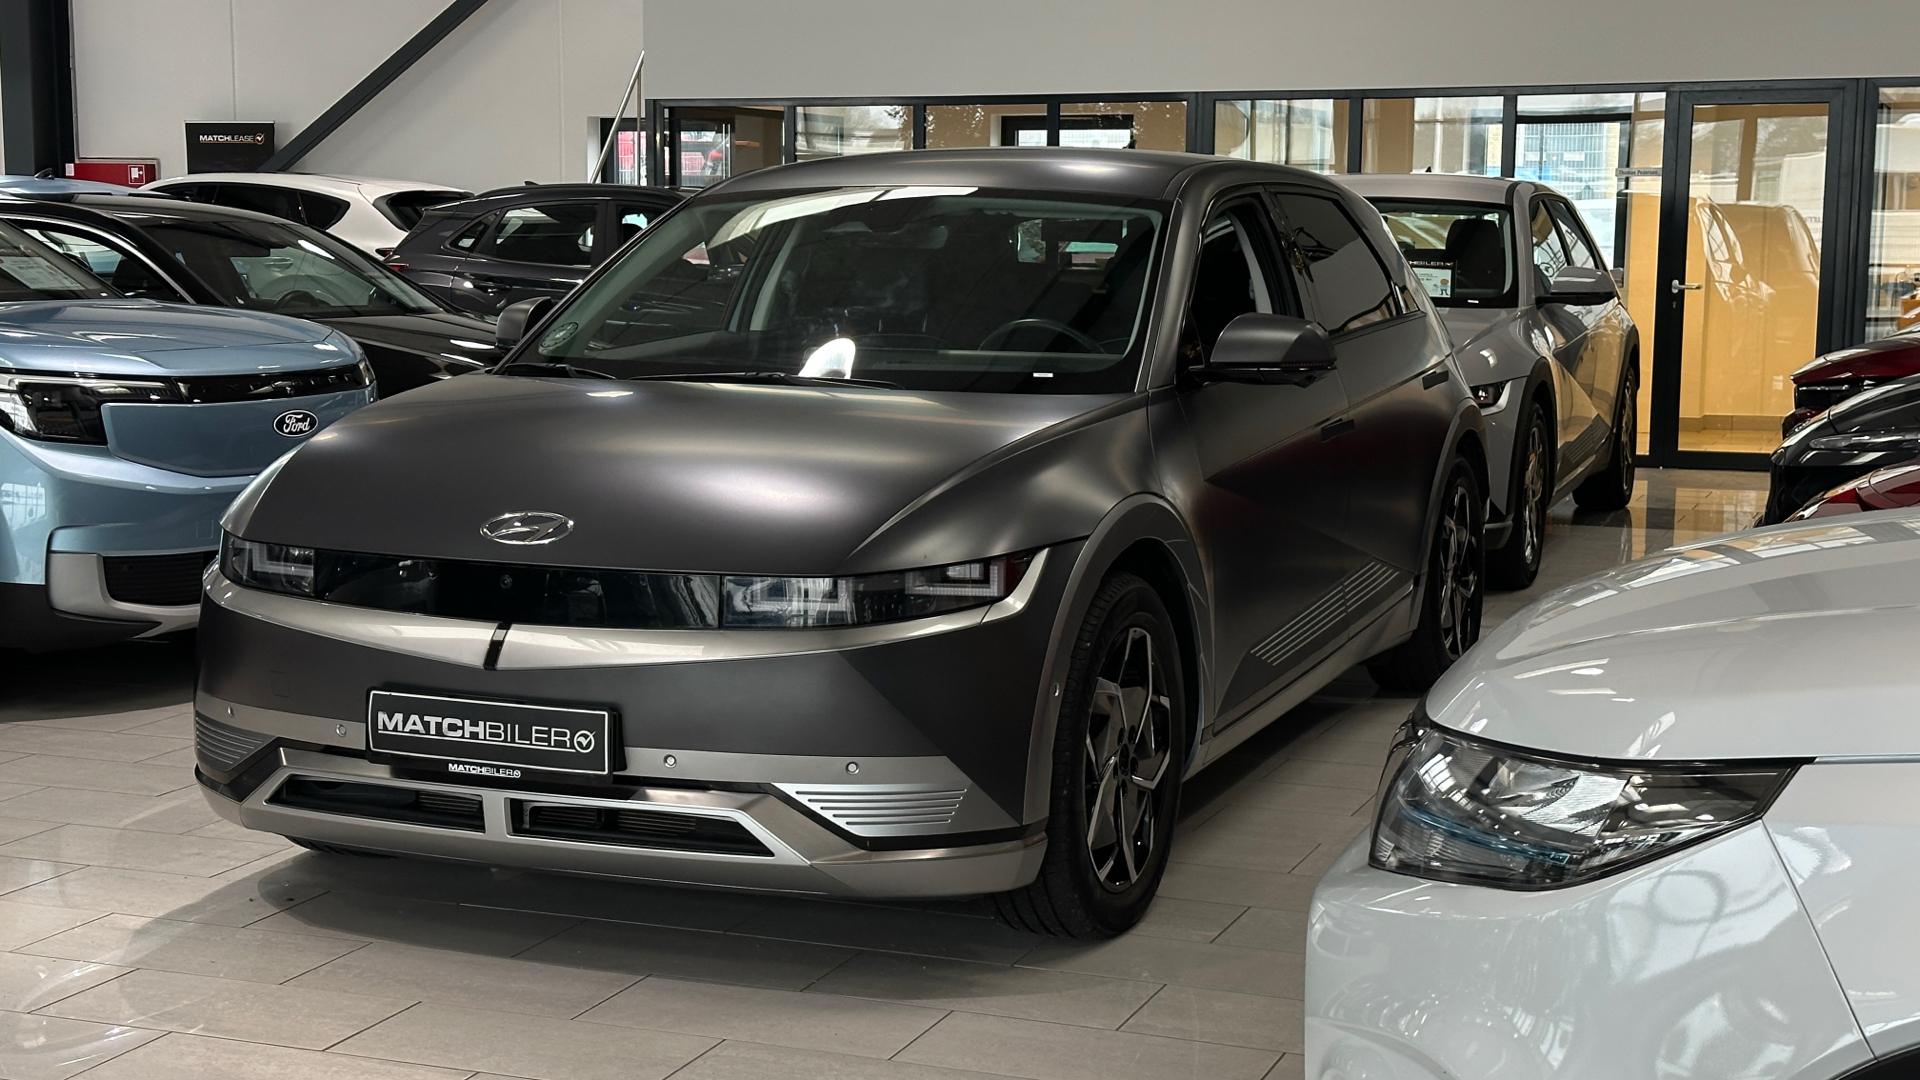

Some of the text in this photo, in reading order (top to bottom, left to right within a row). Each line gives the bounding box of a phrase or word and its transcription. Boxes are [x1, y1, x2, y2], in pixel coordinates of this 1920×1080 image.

[199, 134, 255, 142] MATCHLEASE
[283, 413, 312, 434] Ford
[377, 710, 571, 748] MATCHBILER
[448, 763, 514, 776] MATCHBILER
